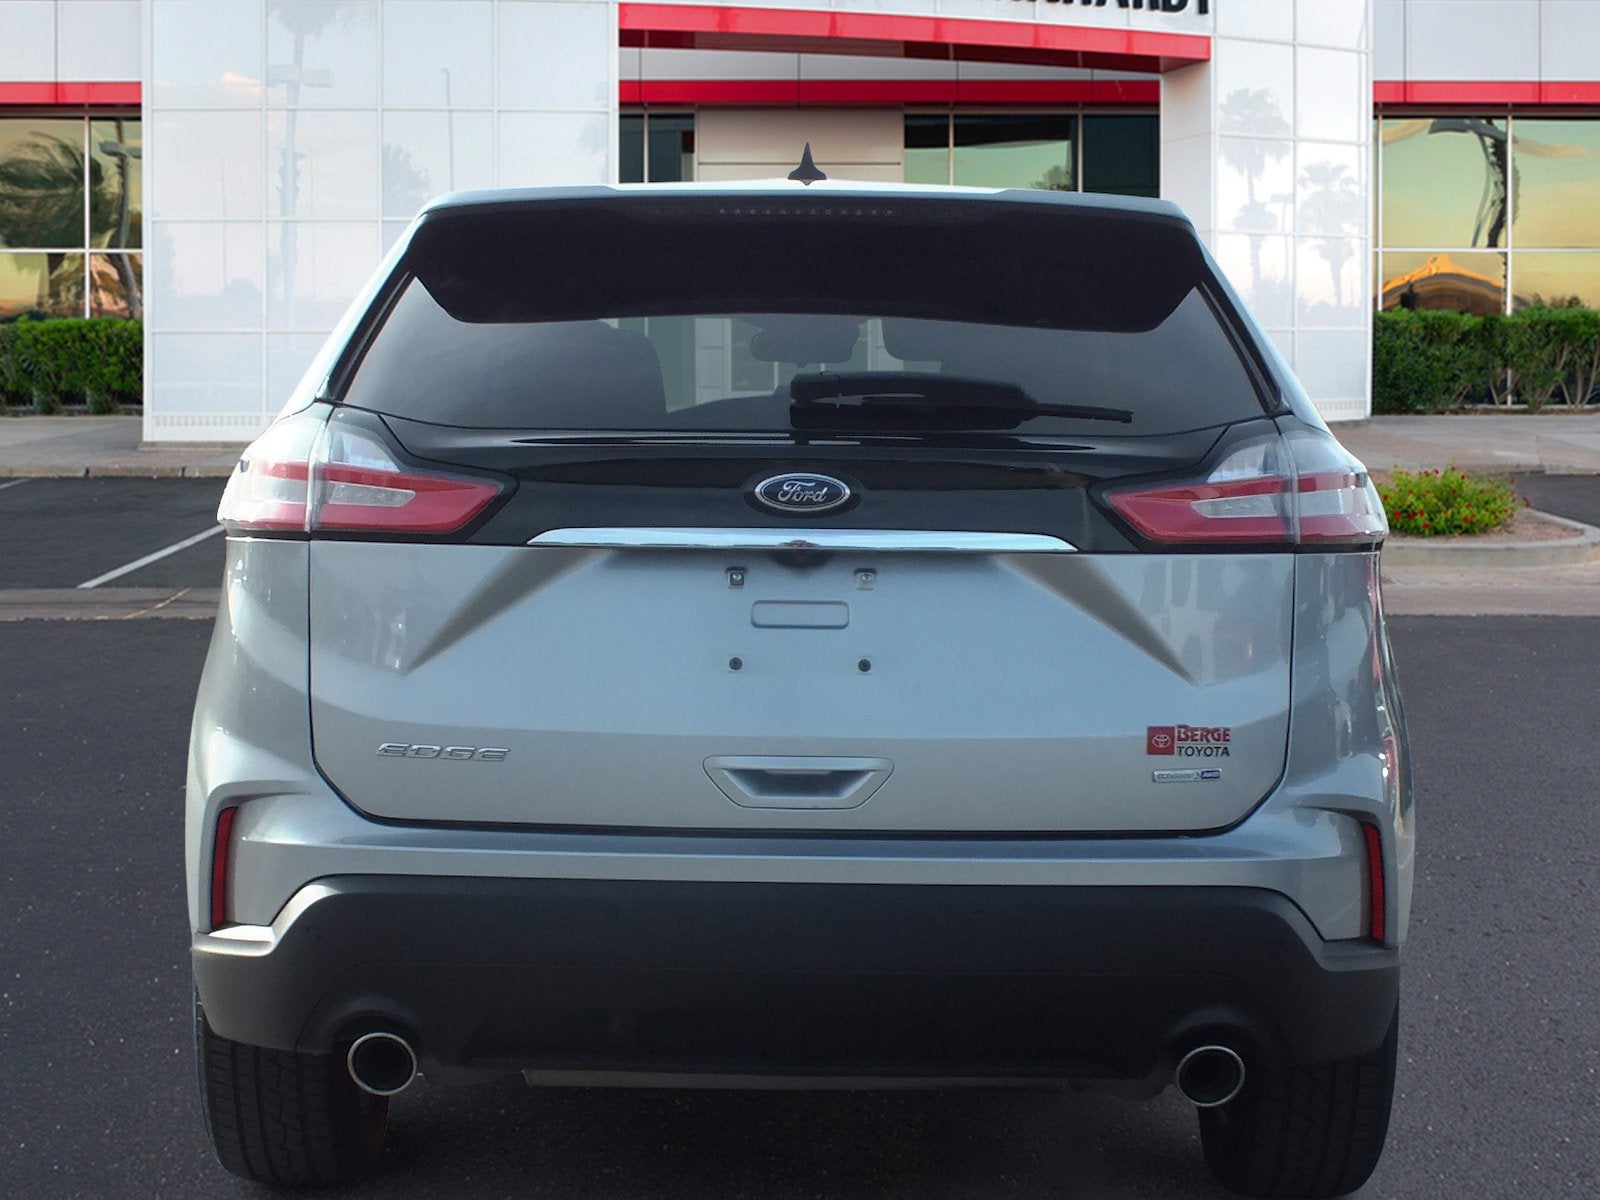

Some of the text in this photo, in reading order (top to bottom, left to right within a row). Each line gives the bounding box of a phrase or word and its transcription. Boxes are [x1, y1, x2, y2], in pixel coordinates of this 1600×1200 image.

[777, 480, 828, 502] Ford
[1176, 724, 1231, 743] BERGE
[376, 742, 510, 762] EDGE
[1177, 745, 1230, 757] TOYOTA
